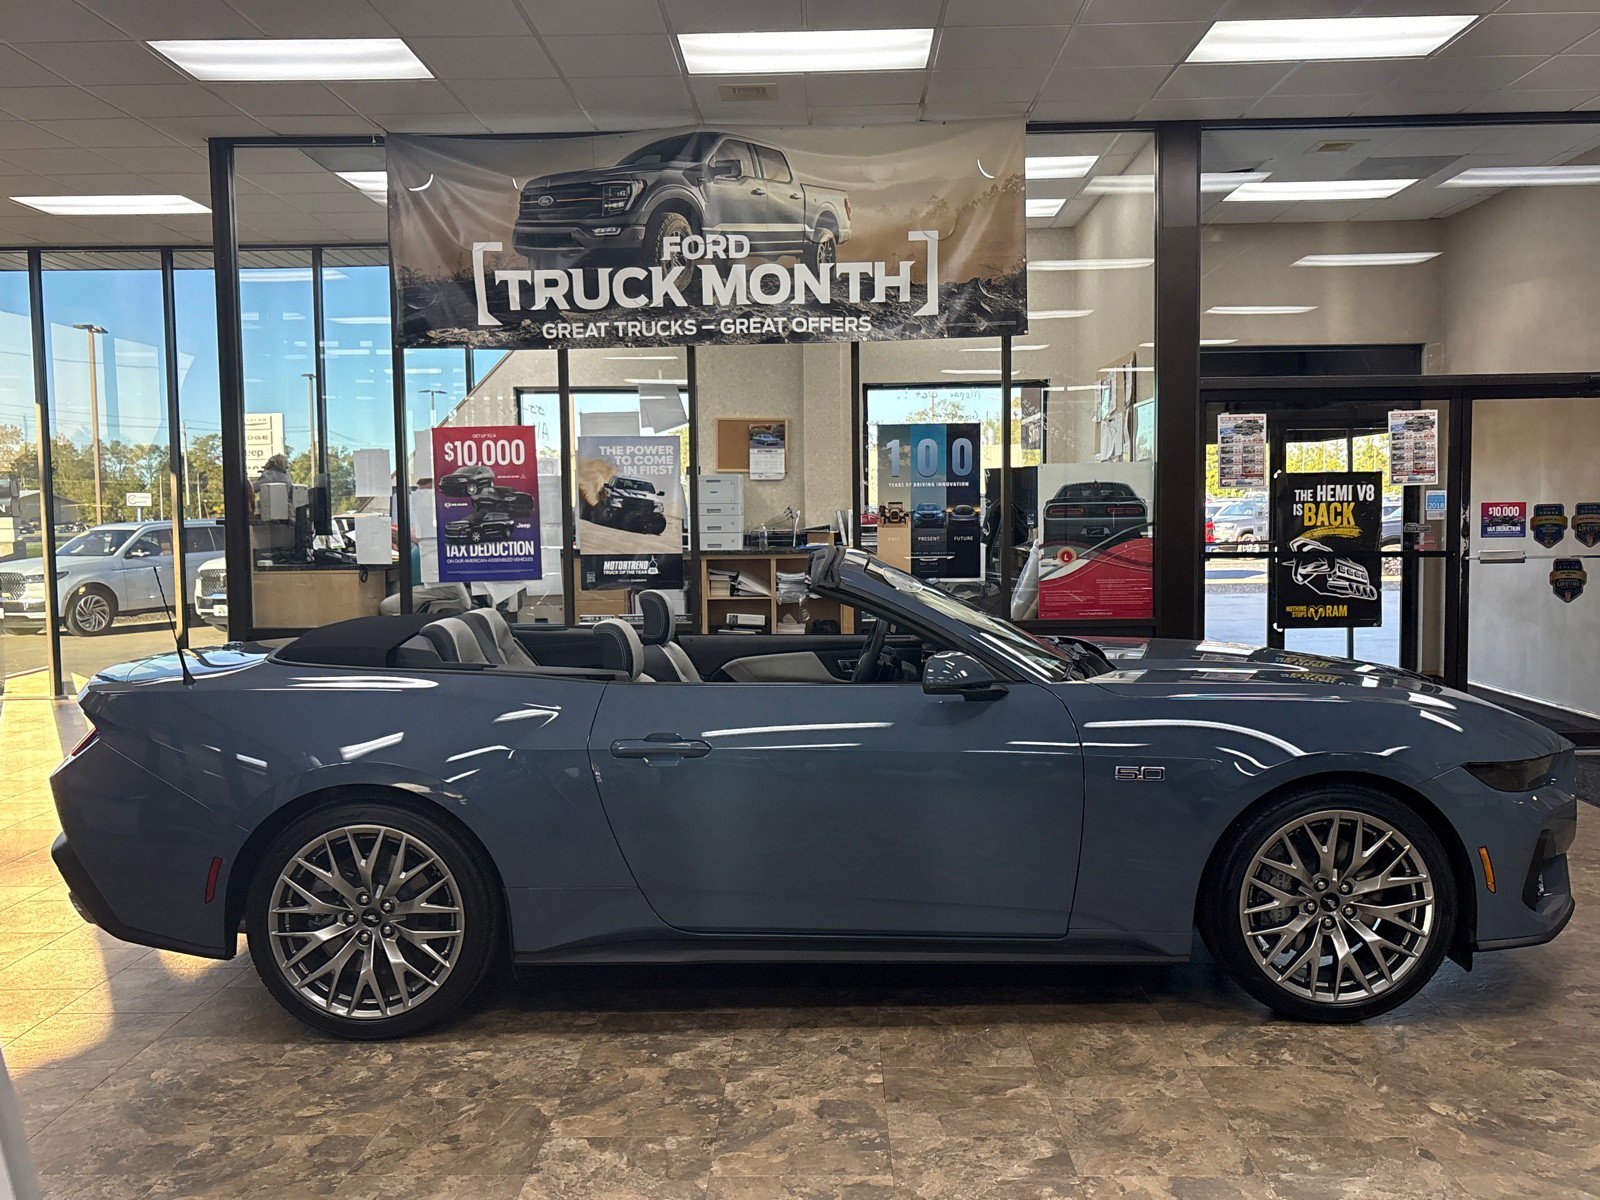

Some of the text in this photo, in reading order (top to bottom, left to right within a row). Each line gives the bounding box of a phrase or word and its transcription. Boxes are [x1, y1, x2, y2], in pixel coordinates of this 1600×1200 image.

[661, 235, 751, 261] FORD
[494, 260, 917, 312] TRUCK MONTH
[542, 322, 611, 340] GREAT
[614, 320, 696, 338] TRUCKS
[720, 318, 789, 336] GREAT
[792, 316, 872, 334] OFFERS
[444, 439, 526, 467] $10,000
[599, 445, 674, 455] THE POWER
[614, 455, 674, 465] TO COME
[623, 465, 674, 475] IN FIRST
[1294, 484, 1375, 502] THE HEMI V8
[1293, 502, 1356, 526] IS BACK
[445, 540, 534, 557] TAX DEDUCTION
[603, 560, 649, 570] MOTORTREND
[1325, 605, 1348, 617] RAM
[1115, 766, 1165, 781] 5.0
